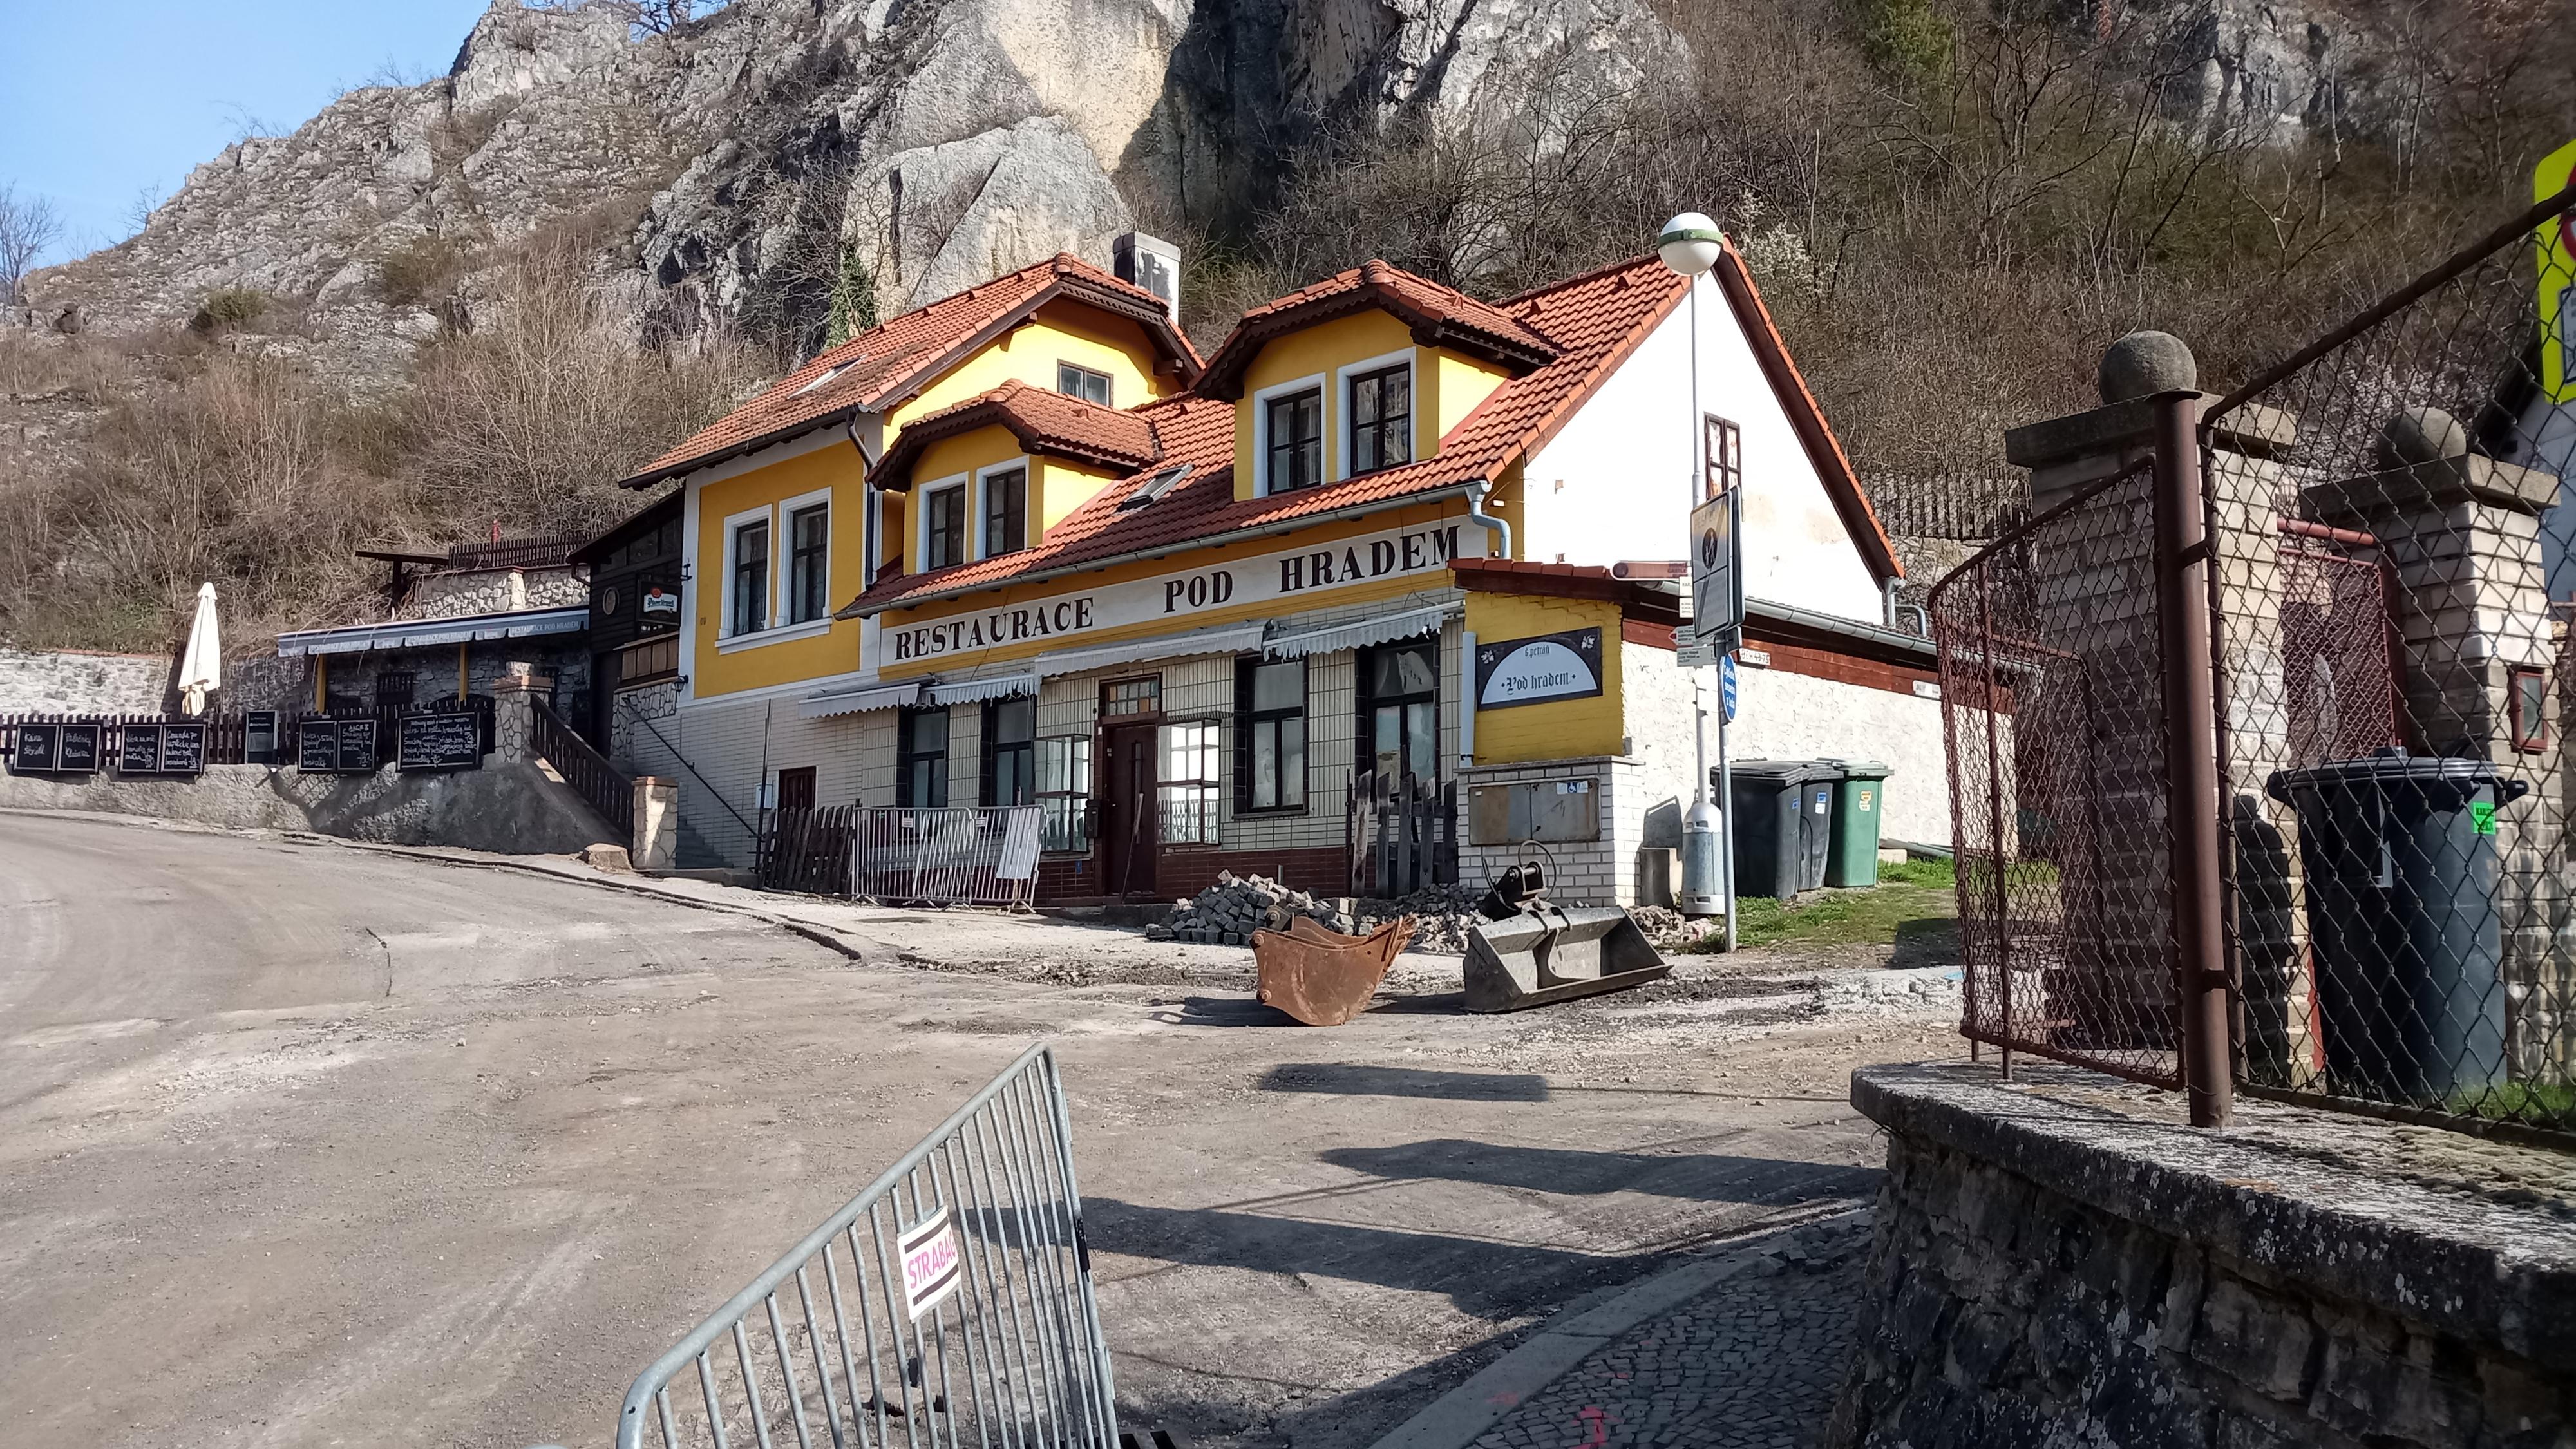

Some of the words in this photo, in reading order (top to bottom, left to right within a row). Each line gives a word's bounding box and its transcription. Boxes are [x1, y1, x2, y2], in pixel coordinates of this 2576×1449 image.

[895, 597, 1094, 660] RESTAURACE
[1164, 571, 1233, 614] POD
[1279, 525, 1460, 594] HRADEM
